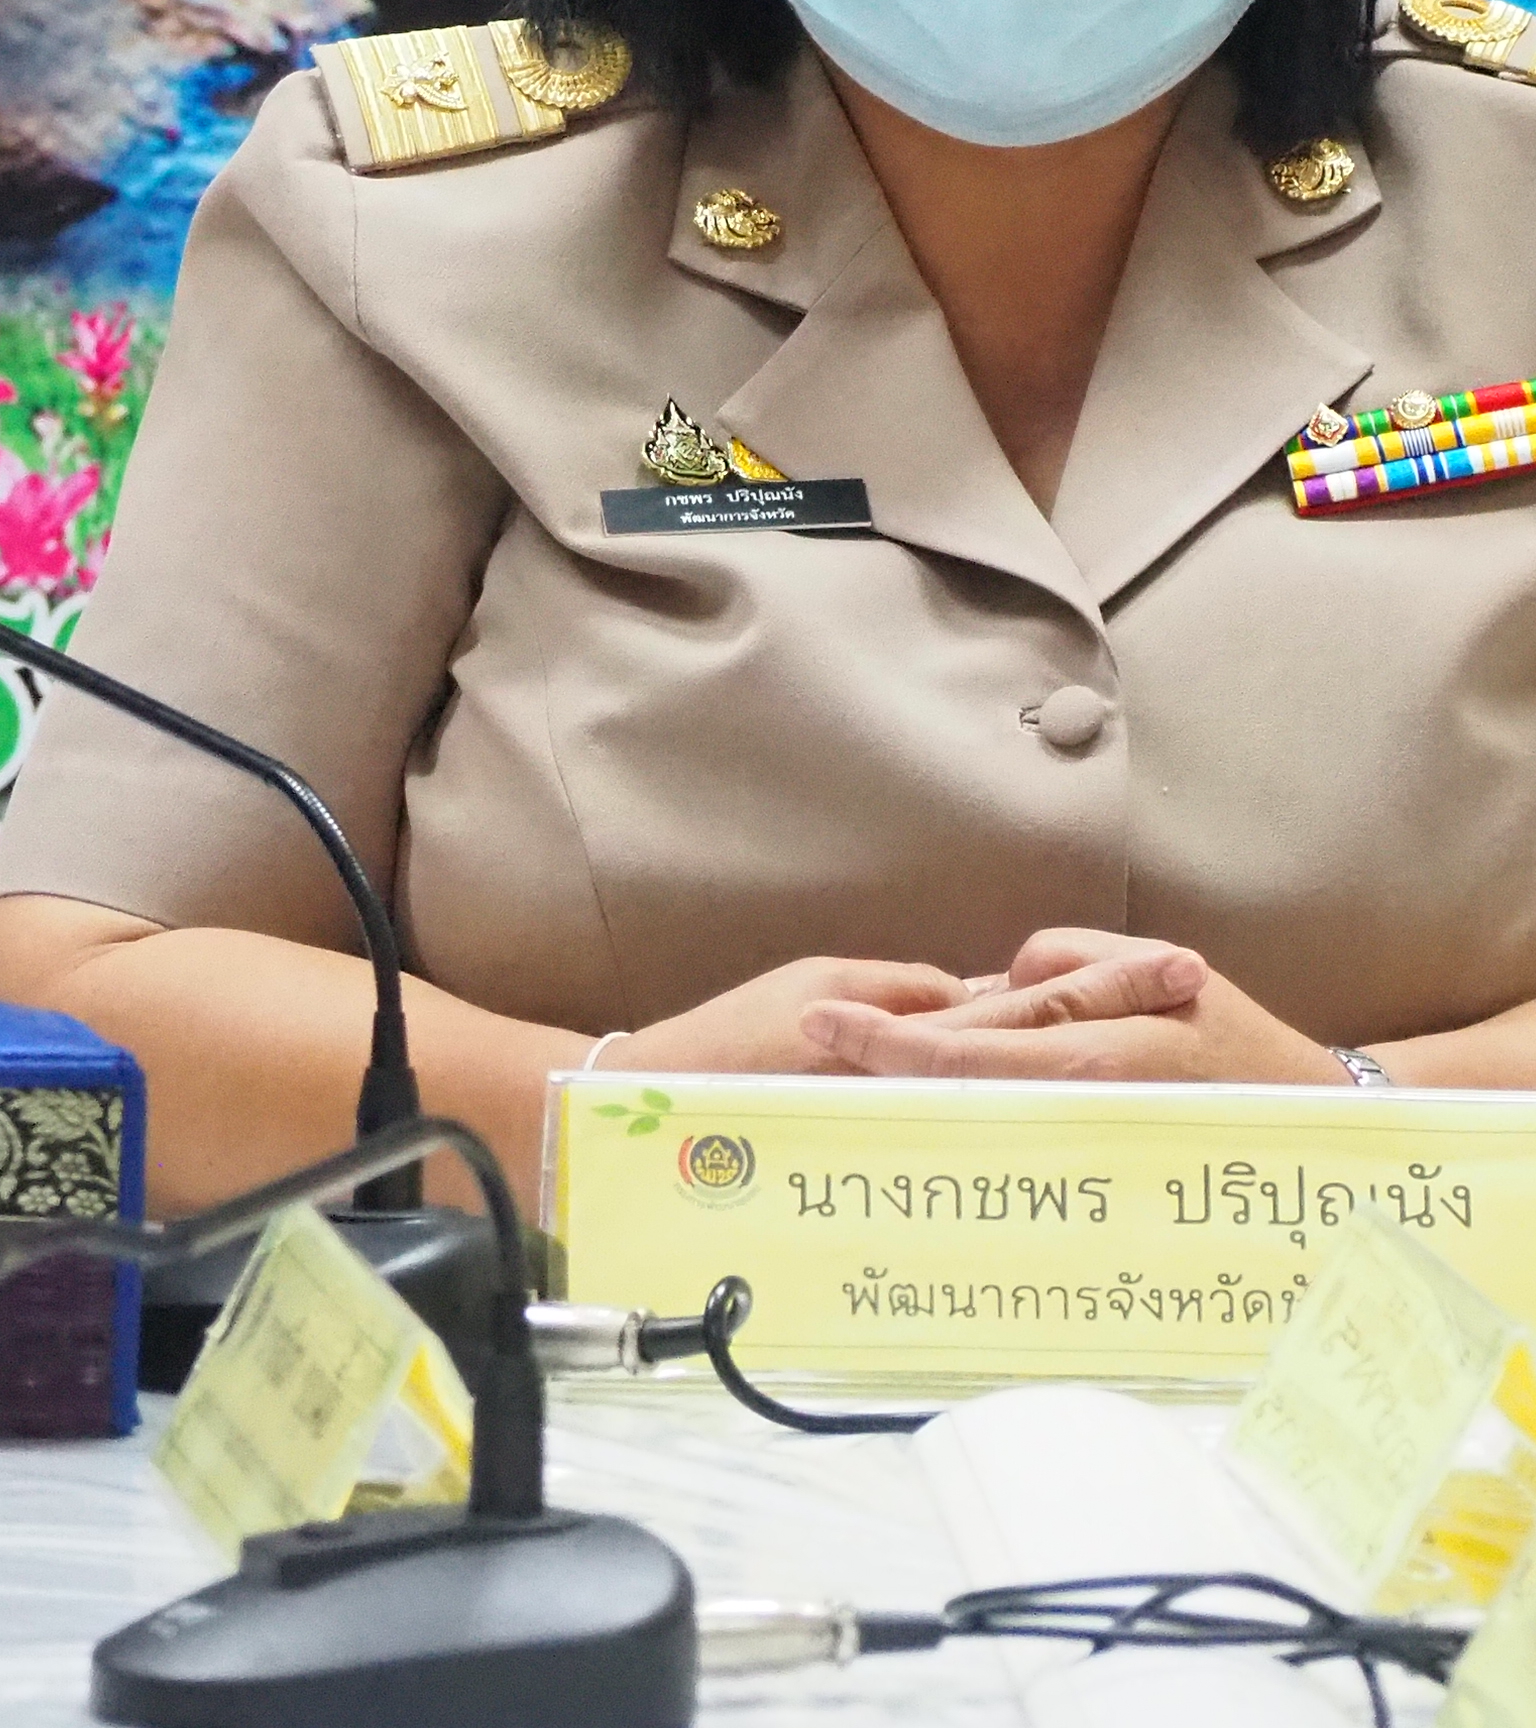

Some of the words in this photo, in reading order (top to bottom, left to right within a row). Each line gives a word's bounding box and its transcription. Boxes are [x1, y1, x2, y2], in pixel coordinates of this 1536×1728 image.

[664, 492, 713, 507] กชพร
[787, 1171, 1114, 1224] นางกชพร
